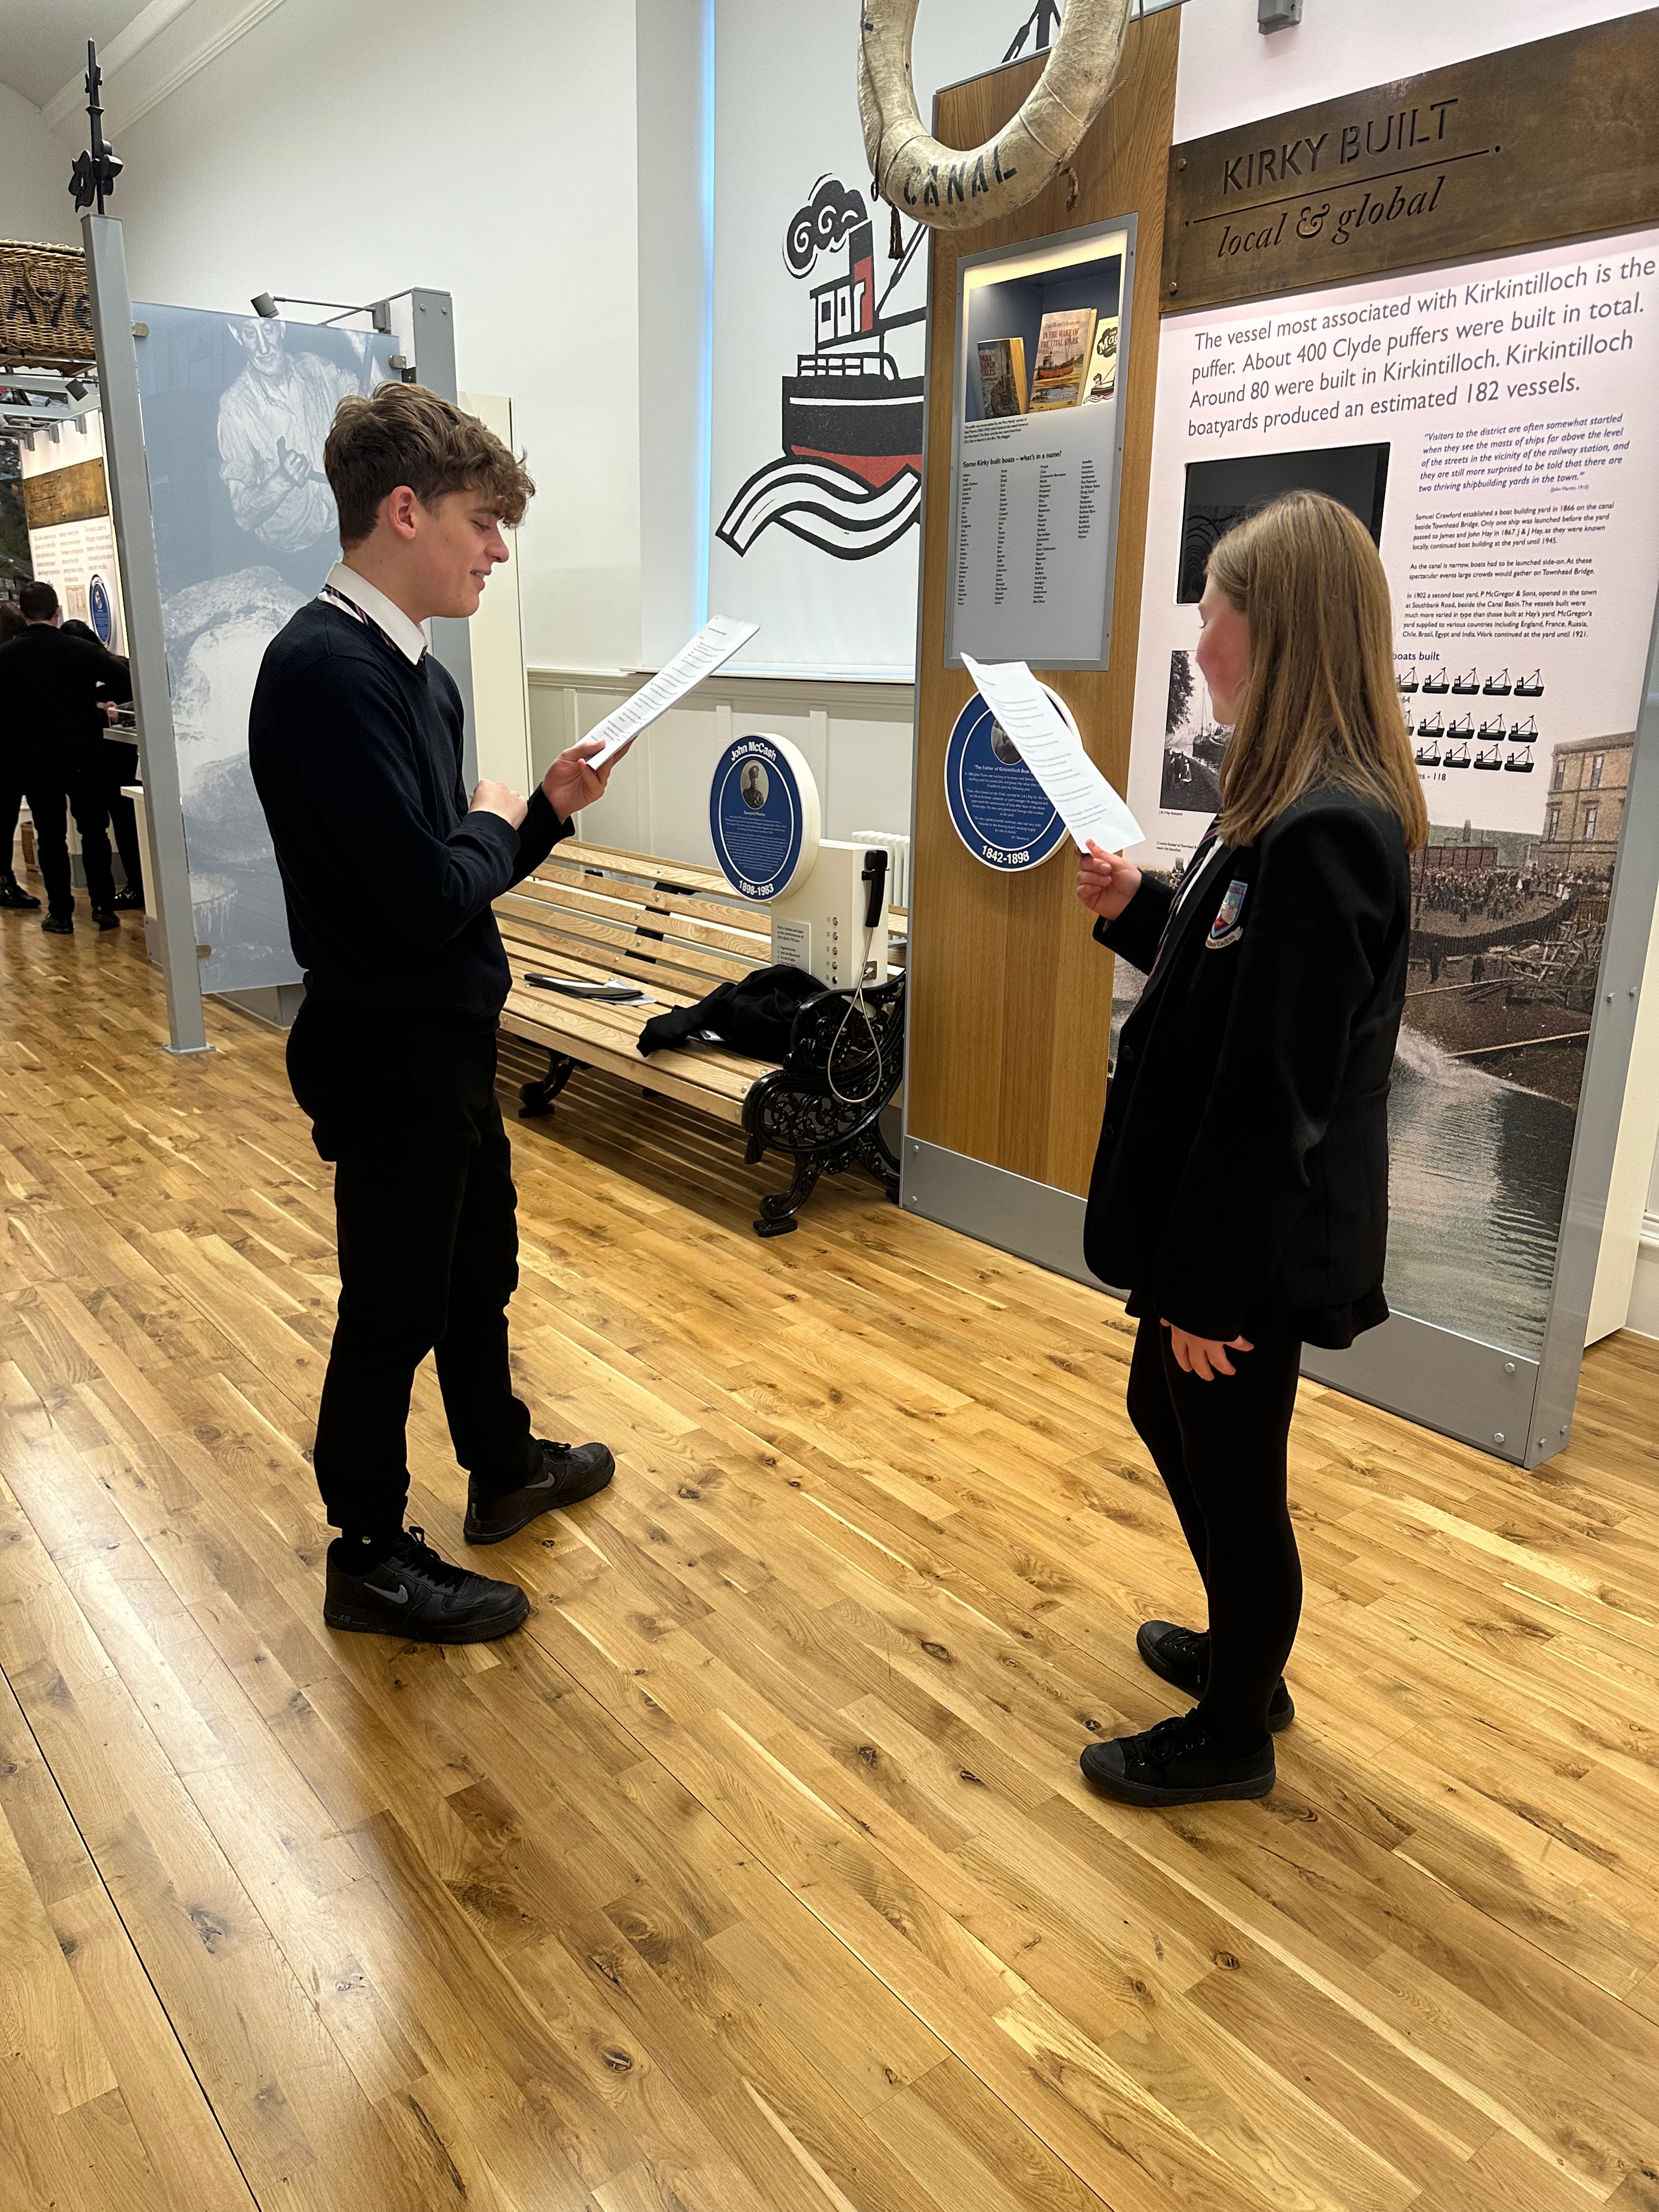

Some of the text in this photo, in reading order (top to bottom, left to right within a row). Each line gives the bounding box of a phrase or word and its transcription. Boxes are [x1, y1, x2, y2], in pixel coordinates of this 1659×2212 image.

[1223, 98, 1458, 195] KIRKY BUILT
[904, 146, 1018, 206] CANAL
[1218, 176, 1446, 258] local & global
[1195, 257, 1656, 350] The vessel most associated with Kirkintilloch is the
[1051, 339, 1064, 347] VITAL
[1065, 337, 1079, 346] SPARK
[1192, 293, 1643, 385] puffer. About 400 Clyde puffers were built in total.
[1190, 330, 1632, 408] Around 80 were built in Kirkintilloch. Kirkintilloch
[1188, 372, 1579, 438] boatyards produced an estimated 182 vessels.
[1466, 429, 1478, 437] the
[1480, 426, 1506, 436] district
[1523, 422, 1544, 433] often
[1546, 418, 1588, 429] somewhat
[1589, 413, 1623, 425] startled
[1444, 444, 1460, 453] they
[1476, 441, 1488, 449] the
[1490, 440, 1512, 448] masts
[1515, 436, 1525, 447] of
[1525, 436, 1545, 446] ships
[1547, 434, 1559, 445] far
[1561, 432, 1585, 441] above
[1588, 430, 1601, 439] the
[1603, 427, 1624, 437] level
[1046, 450, 1062, 458] name?
[1421, 458, 1430, 468] of
[1431, 457, 1442, 466] the
[1480, 453, 1491, 462] the
[1494, 451, 1521, 461] vicinity
[1522, 449, 1533, 460] of
[1533, 448, 1546, 457] the
[1548, 446, 1578, 456] railway
[1579, 444, 1610, 453] station,
[1613, 441, 1630, 450] and
[1420, 471, 1436, 481] they
[1451, 468, 1464, 477] still
[1487, 463, 1522, 475] surprised
[1535, 462, 1545, 470] be
[1547, 460, 1563, 469] told
[1565, 459, 1582, 468] that
[1584, 457, 1606, 466] there
[1433, 482, 1461, 492] thriving
[1463, 478, 1507, 490] shipbuilding
[1508, 476, 1530, 488] yards
[1542, 474, 1554, 483] the
[1460, 520, 1479, 529] Bridge.
[1595, 513, 1610, 521] yard
[1463, 509, 1493, 518] established
[1537, 505, 1551, 514] yard
[1512, 570, 1532, 578] gather
[1574, 567, 1595, 576] Bridge.
[1419, 651, 1439, 660] built
[731, 742, 776, 761] John McCash
[1434, 773, 1446, 781] 118
[982, 845, 1030, 864] 1842-1898
[739, 880, 774, 896] 1898-1983
[338, 1614, 351, 1624] AIR
